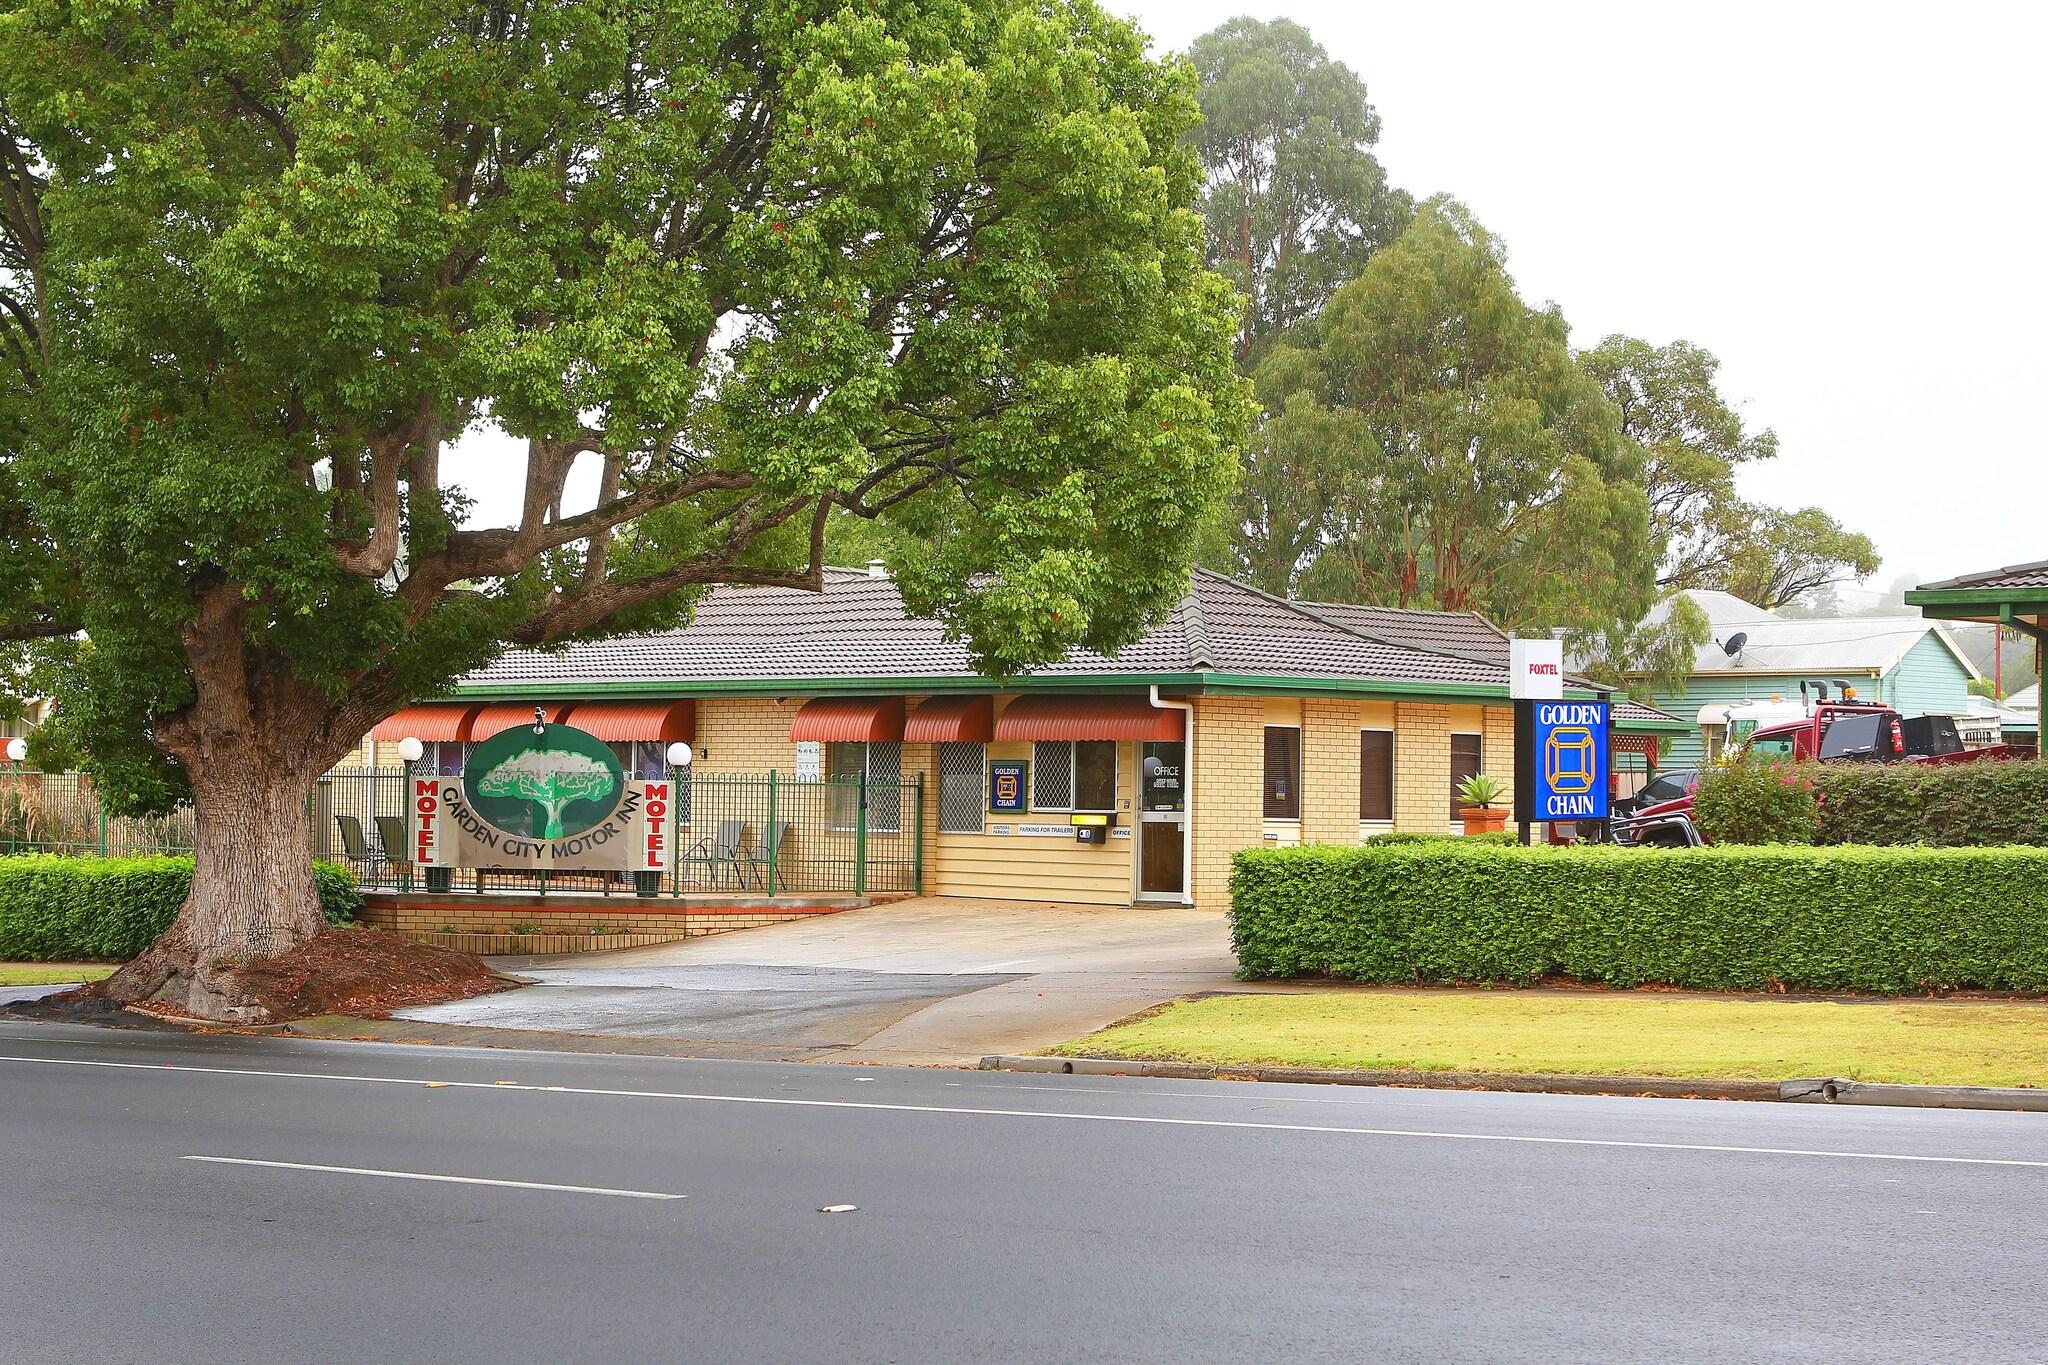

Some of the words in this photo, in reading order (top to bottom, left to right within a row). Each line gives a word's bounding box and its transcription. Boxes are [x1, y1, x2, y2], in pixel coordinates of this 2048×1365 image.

[1529, 663, 1558, 675] FOXTEL
[1540, 705, 1601, 725] GOLDEN
[1153, 766, 1179, 776] OFFICE
[997, 799, 1016, 807] CHAIN
[1547, 796, 1594, 815] CHAIN
[416, 780, 439, 863] MOTEL
[443, 787, 498, 848] GARDEN
[503, 840, 546, 859] CITY
[551, 822, 620, 859] MOTOR
[618, 790, 642, 824] INN
[645, 784, 668, 867] MOTEL
